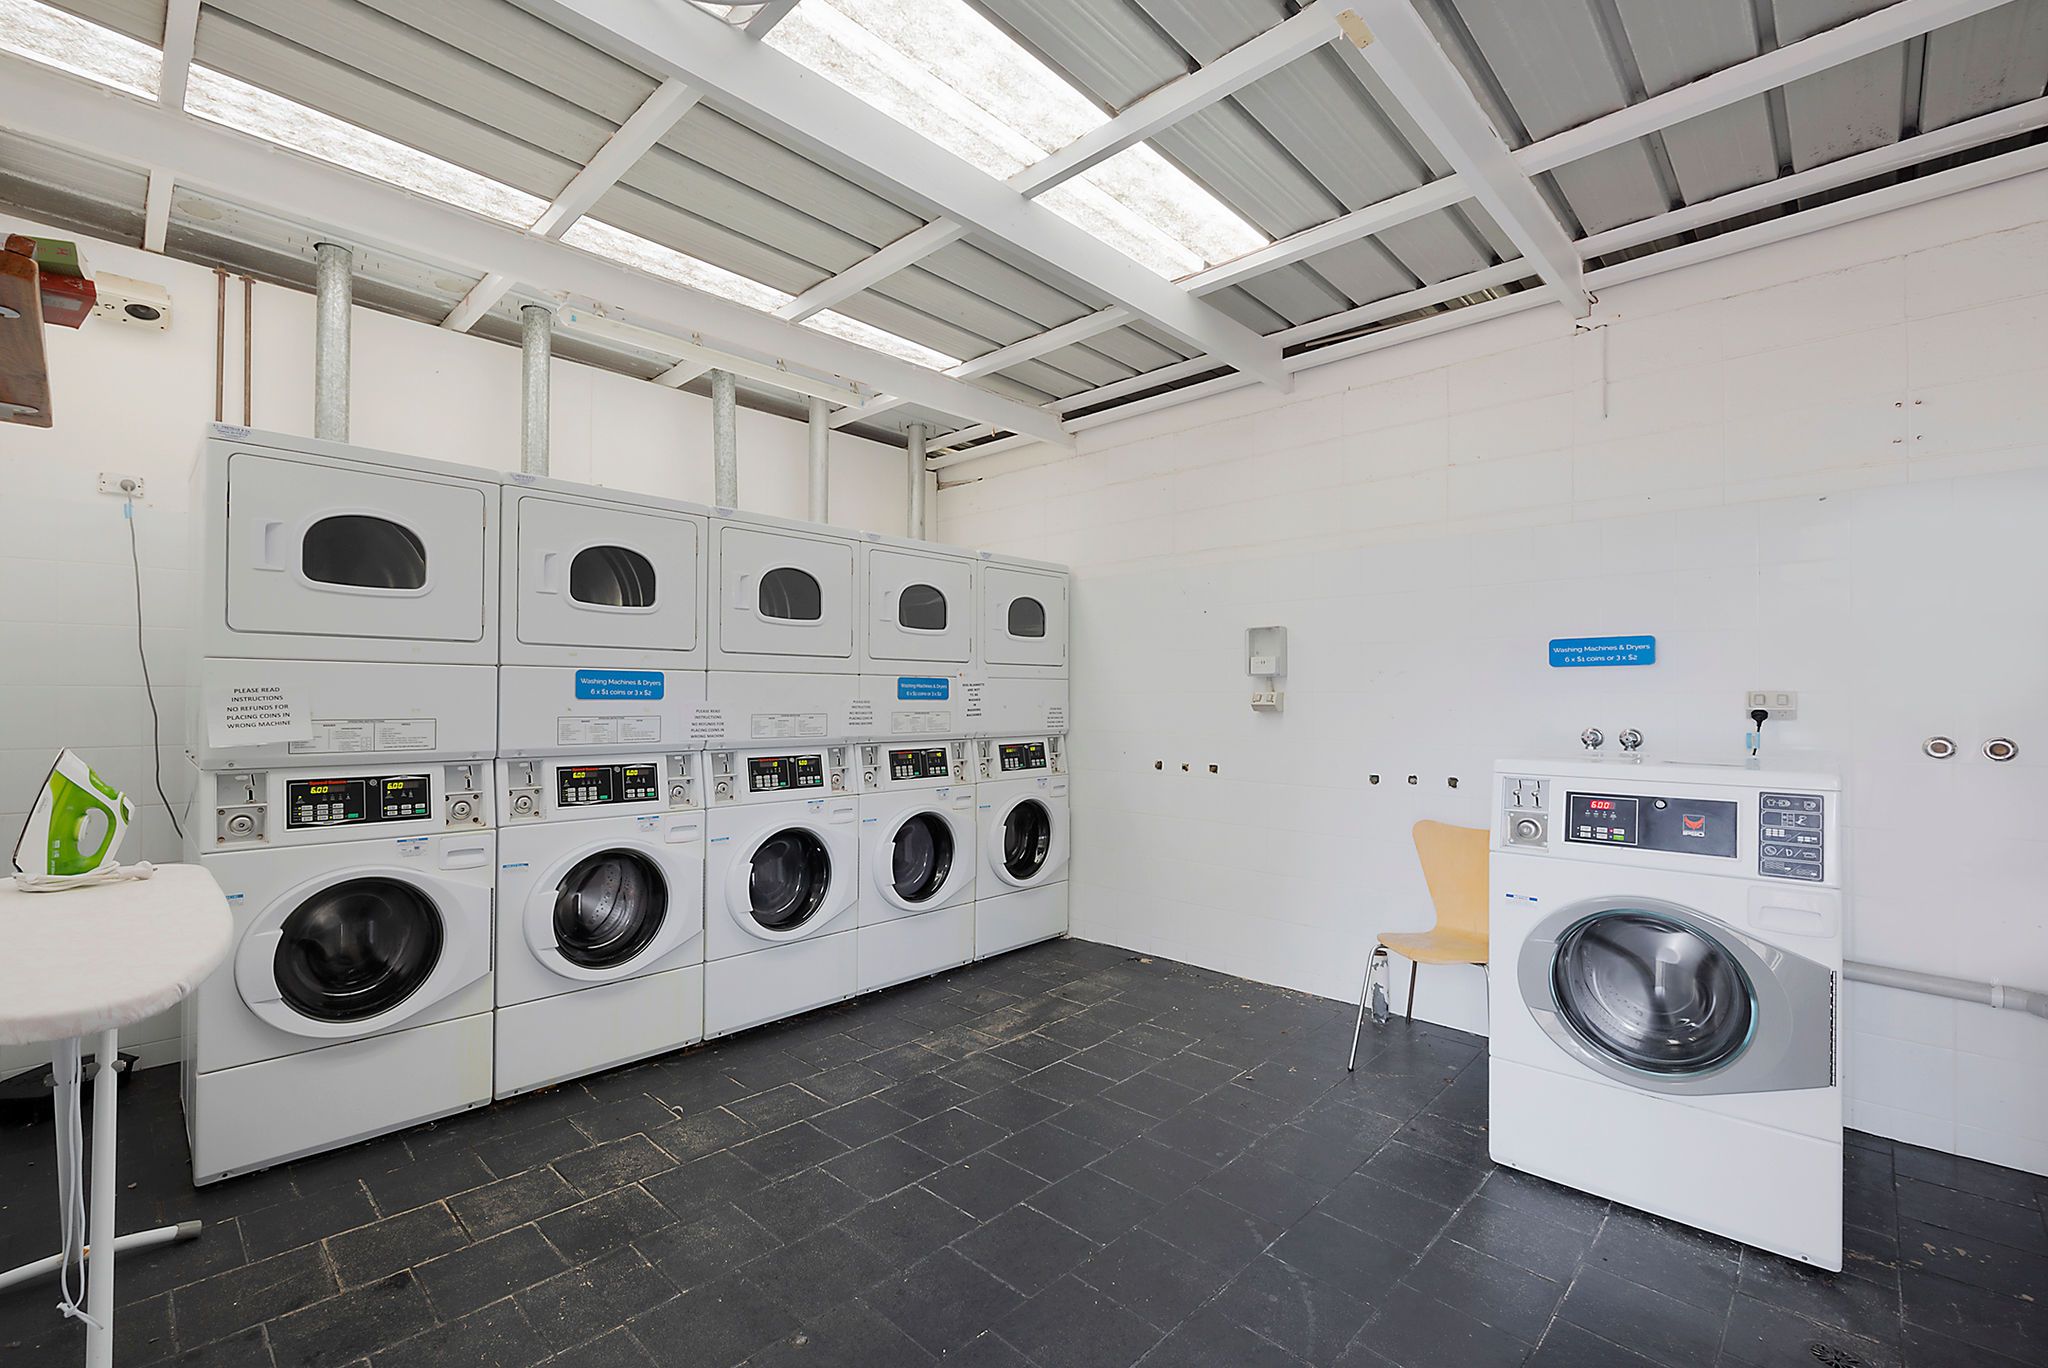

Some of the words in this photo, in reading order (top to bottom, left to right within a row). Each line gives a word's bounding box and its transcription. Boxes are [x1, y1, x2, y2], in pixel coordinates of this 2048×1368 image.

[581, 678, 607, 686] Washing
[310, 786, 328, 794] 6.00
[387, 782, 404, 790] 6.00
